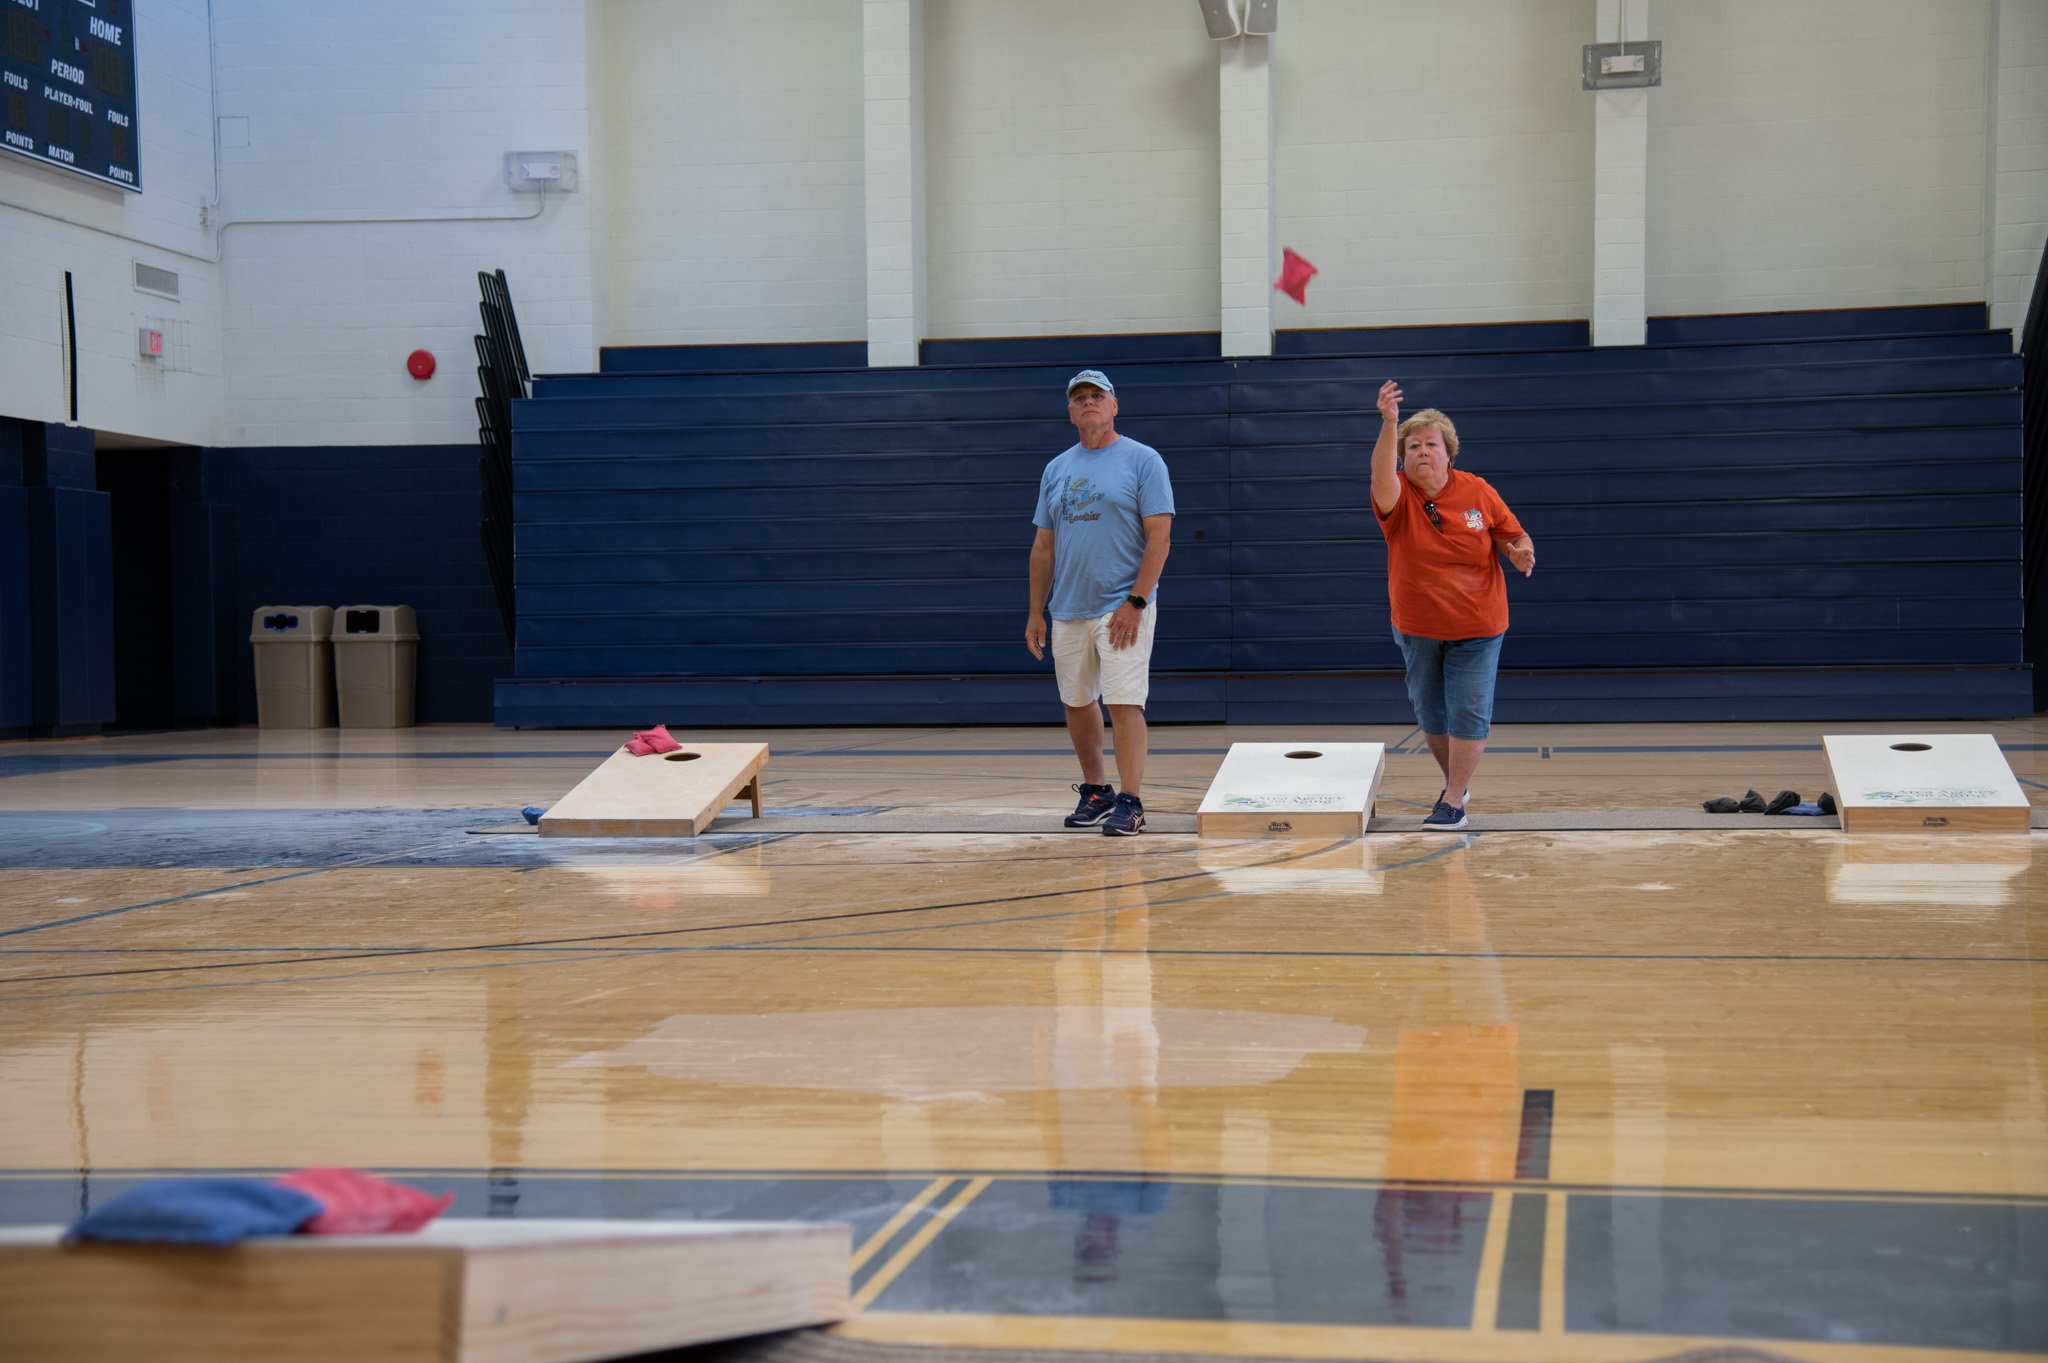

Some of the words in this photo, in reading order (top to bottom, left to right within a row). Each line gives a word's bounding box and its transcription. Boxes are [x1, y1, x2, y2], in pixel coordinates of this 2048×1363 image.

[90, 16, 122, 46] HOME
[4, 71, 29, 91] FOULS
[51, 59, 85, 86] PERIOD
[44, 86, 94, 115] PLAYER-FOUL
[107, 110, 129, 127] FOULS
[5, 130, 34, 150] POINTS
[48, 145, 74, 164] MATCH
[109, 165, 134, 183] POINTS
